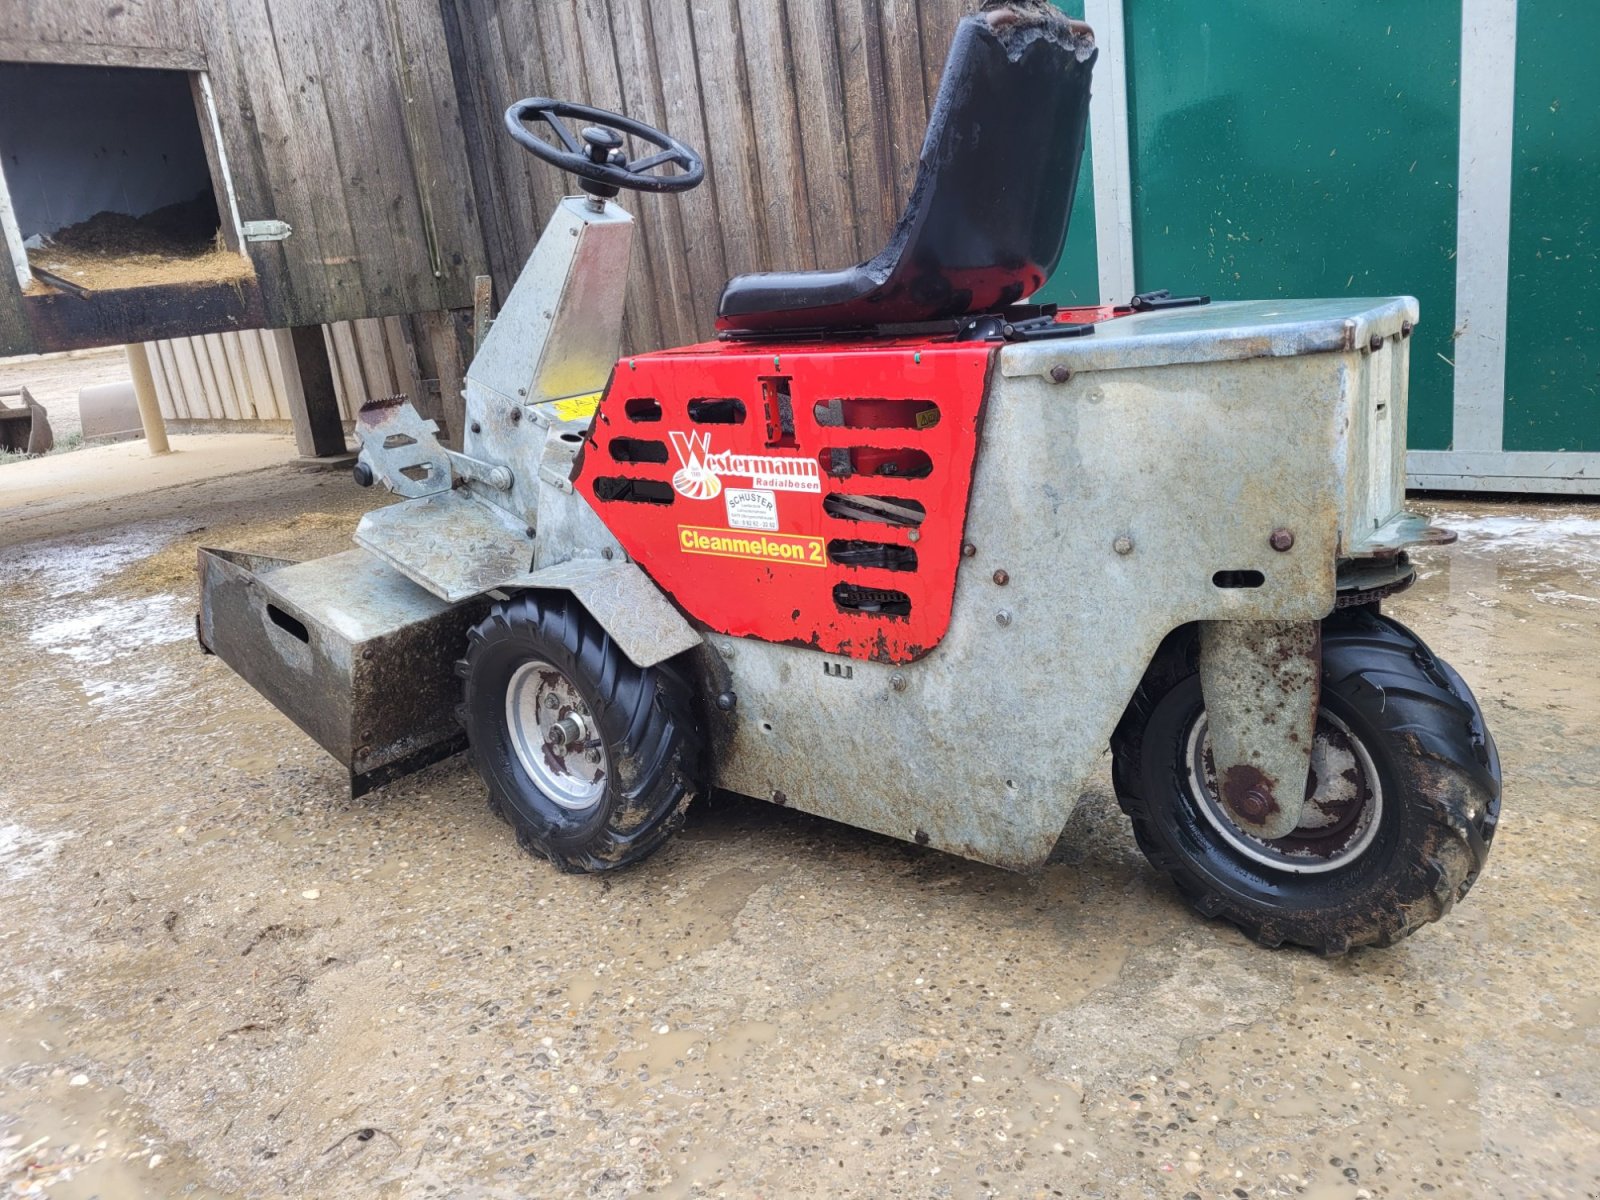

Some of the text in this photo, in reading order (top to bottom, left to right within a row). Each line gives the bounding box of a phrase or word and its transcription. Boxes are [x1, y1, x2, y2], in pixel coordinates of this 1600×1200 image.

[669, 429, 818, 477] Westermann
[756, 478, 819, 490] Radialbesen
[729, 493, 773, 511] SCHUSTER
[681, 530, 822, 561] Cleanmeleon 2
